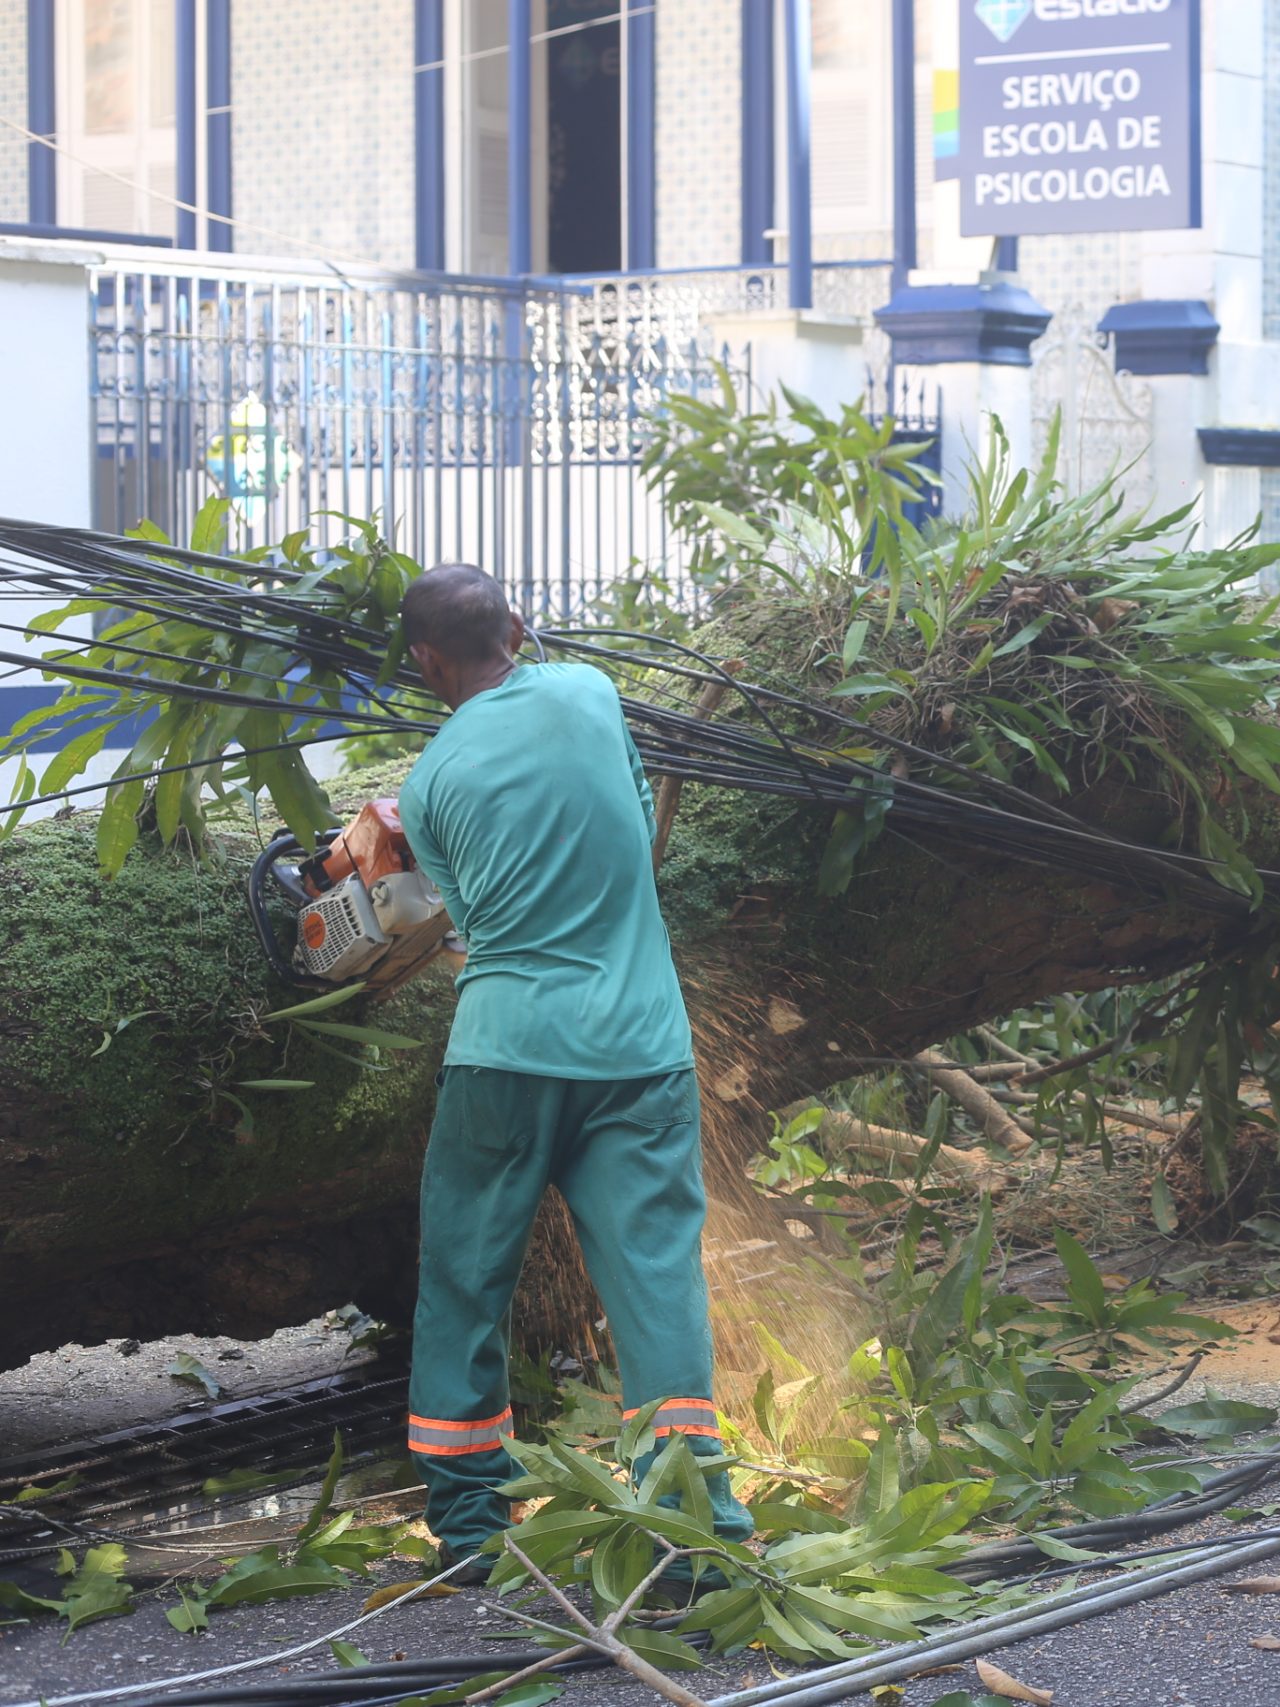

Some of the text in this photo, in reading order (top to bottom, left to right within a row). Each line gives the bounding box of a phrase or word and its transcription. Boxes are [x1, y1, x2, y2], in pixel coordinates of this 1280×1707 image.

[1002, 68, 1141, 111] SERVIÇO
[982, 115, 1162, 158] ESCOLA DE
[975, 164, 1171, 206] PSICOLOGIA
